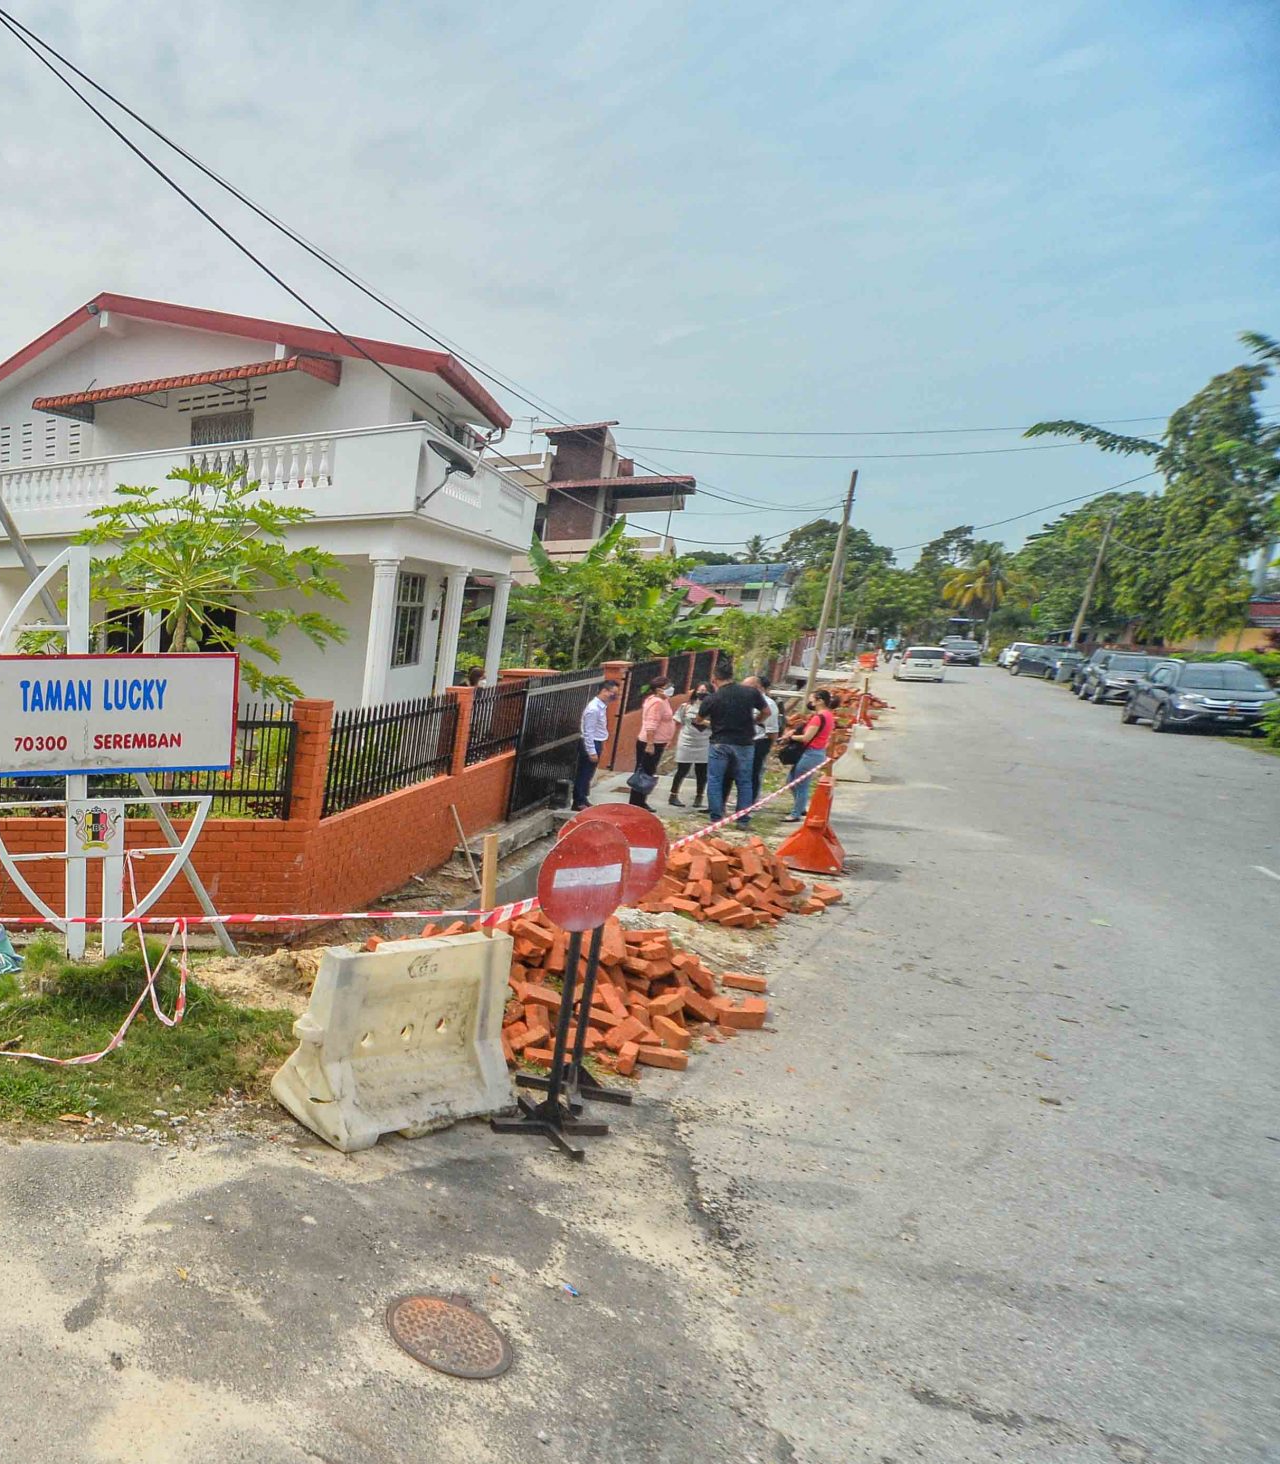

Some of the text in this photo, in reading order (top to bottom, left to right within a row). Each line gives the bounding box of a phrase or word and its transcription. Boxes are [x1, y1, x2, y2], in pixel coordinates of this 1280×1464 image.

[20, 679, 167, 712] TAMAN LUCKY
[14, 733, 182, 752] 70300 SEREMBAN
[86, 824, 105, 832] MBS
